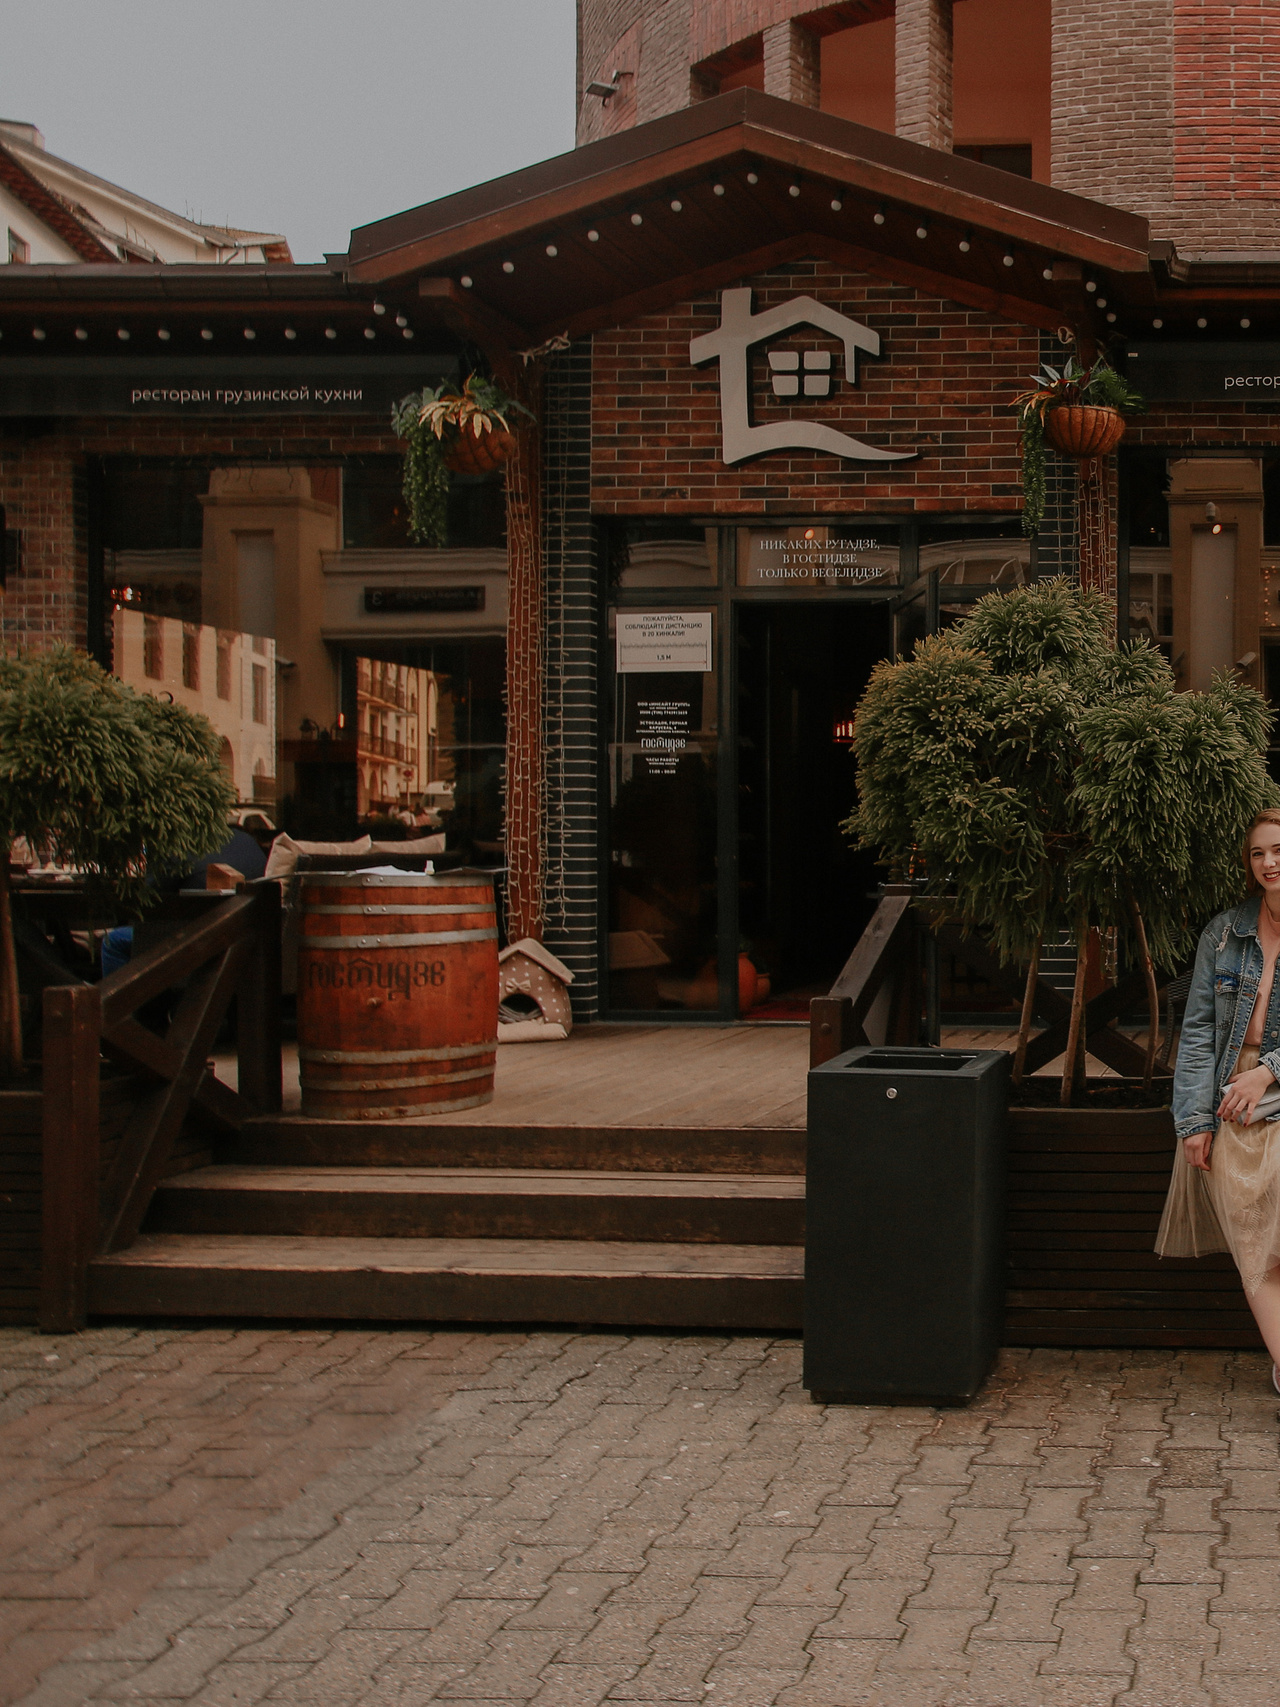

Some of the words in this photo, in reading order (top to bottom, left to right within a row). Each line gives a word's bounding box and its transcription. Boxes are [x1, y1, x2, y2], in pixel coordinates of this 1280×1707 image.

[132, 389, 210, 404] ресторан
[216, 386, 309, 404] грузинской
[315, 389, 363, 403] кухни
[760, 539, 822, 550] НИКАКИХ
[825, 538, 881, 551] РУГАДЗЕ,
[783, 554, 790, 564] В
[793, 553, 858, 565] ГОСТИДЗЕ
[757, 568, 809, 578] ТОЛЬКО
[812, 567, 883, 579] ВЕСЕЛИДЗЕ
[643, 615, 684, 623] ПОЖАЛУЙСТА,
[665, 622, 703, 630] ДИСТАНЦИЮ
